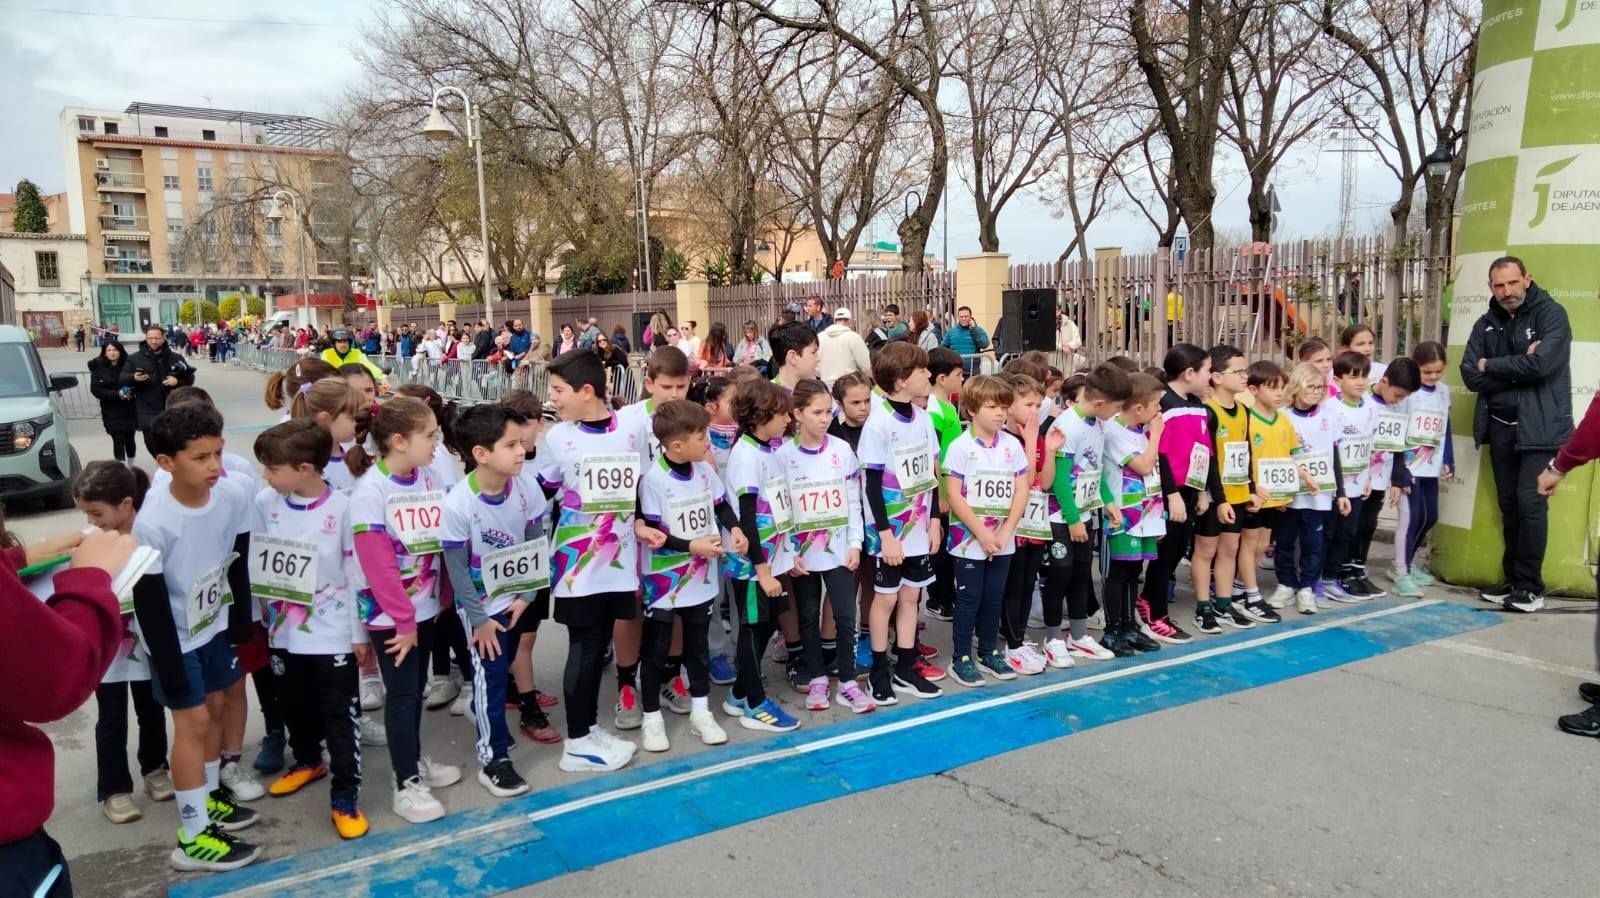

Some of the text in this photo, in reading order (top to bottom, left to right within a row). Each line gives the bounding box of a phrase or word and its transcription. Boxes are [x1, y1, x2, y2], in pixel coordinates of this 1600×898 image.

[1551, 202, 1568, 211] DE
[584, 467, 634, 491] 1698
[1263, 467, 1296, 484] 1638
[799, 489, 842, 511] 1713
[974, 479, 1012, 499] 1665
[394, 506, 441, 532] 1702
[259, 549, 313, 578] 1667
[488, 552, 539, 580] 1661
